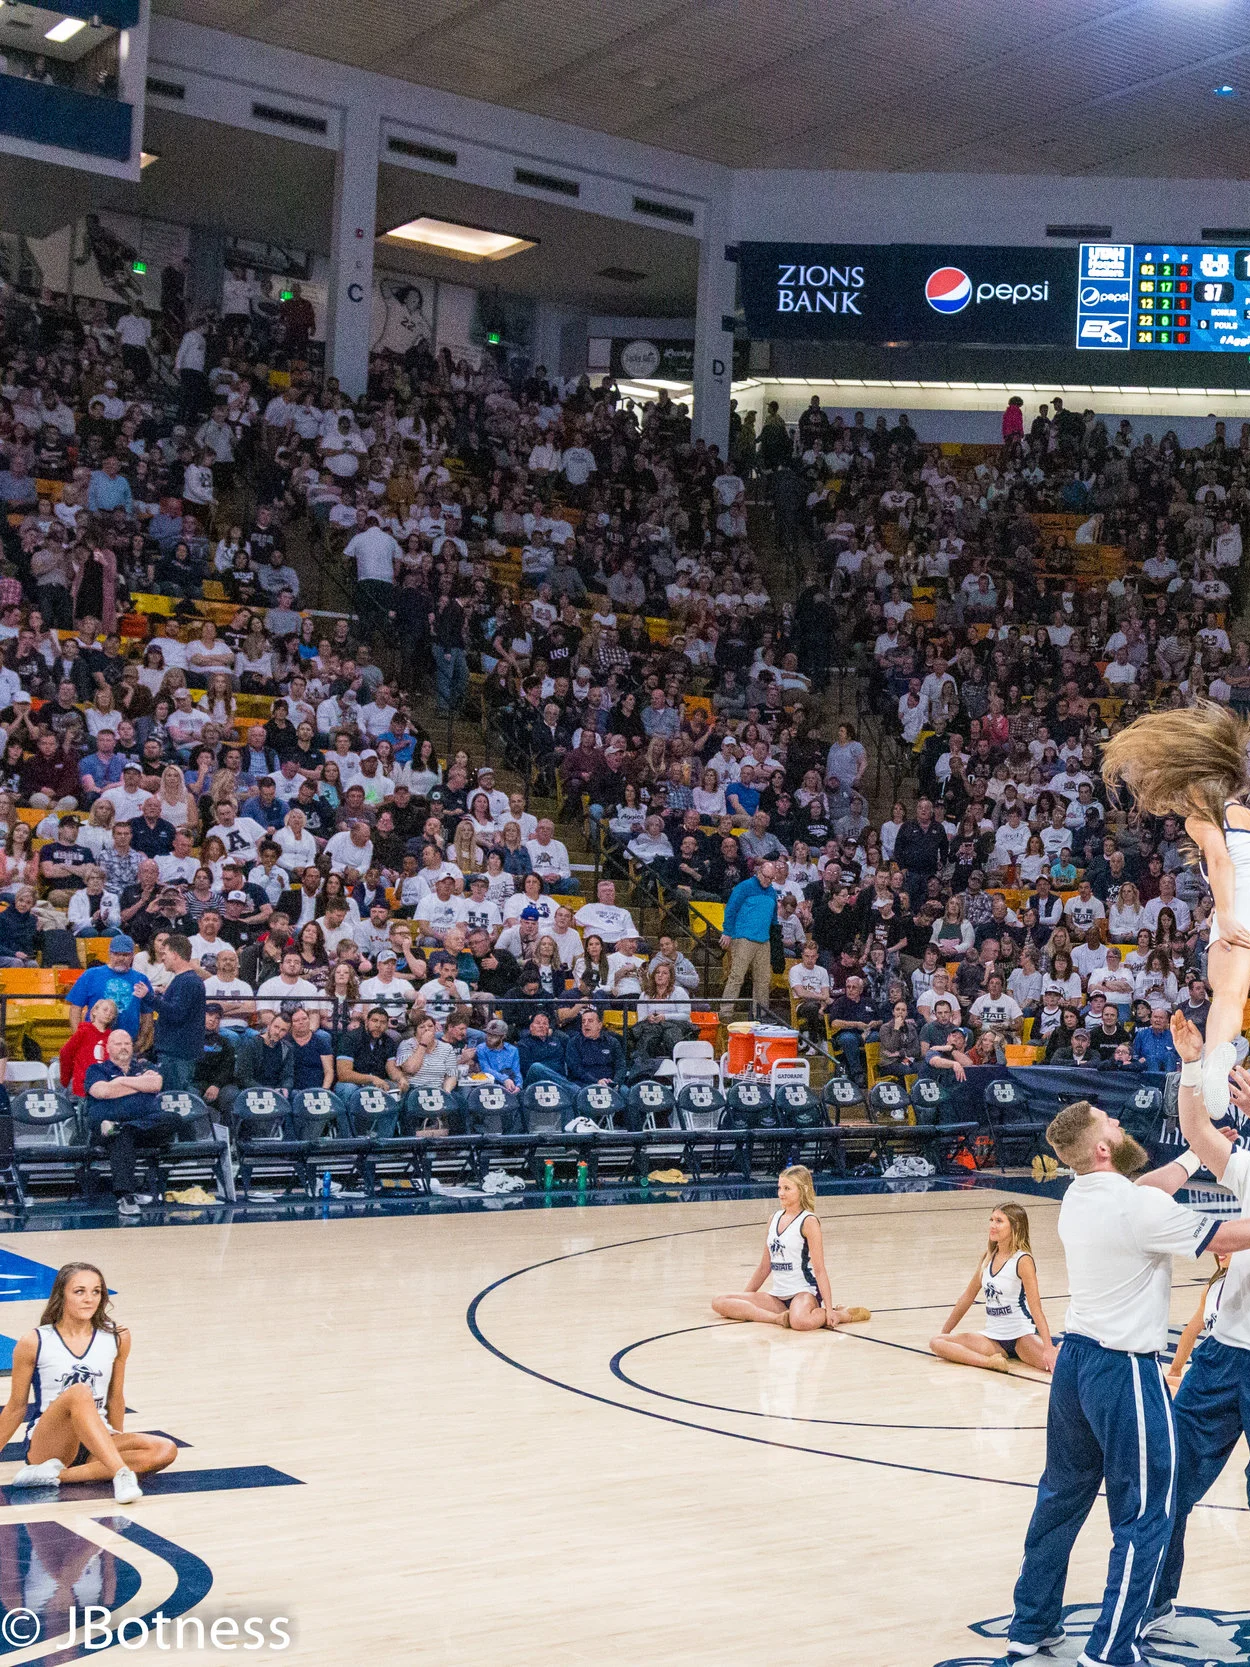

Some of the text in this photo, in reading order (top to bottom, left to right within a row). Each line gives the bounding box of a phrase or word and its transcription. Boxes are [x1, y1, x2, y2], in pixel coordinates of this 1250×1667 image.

[778, 264, 864, 287] ZIONS
[1163, 266, 1170, 275] 2
[1180, 265, 1187, 275] 2
[348, 284, 363, 302] C
[977, 281, 1049, 304] pepsi
[1161, 282, 1172, 292] 17
[1204, 283, 1222, 302] 37
[777, 290, 862, 315] BANK
[1100, 292, 1129, 302] pepsi
[1141, 299, 1187, 309] 12 2 1
[1080, 320, 1127, 338] EK
[1140, 316, 1153, 326] 22
[1162, 316, 1169, 326] 0
[1200, 320, 1207, 328] 0
[1138, 332, 1153, 343] 24
[1161, 332, 1169, 343] 5
[712, 359, 724, 376] D
[226, 830, 250, 850] A
